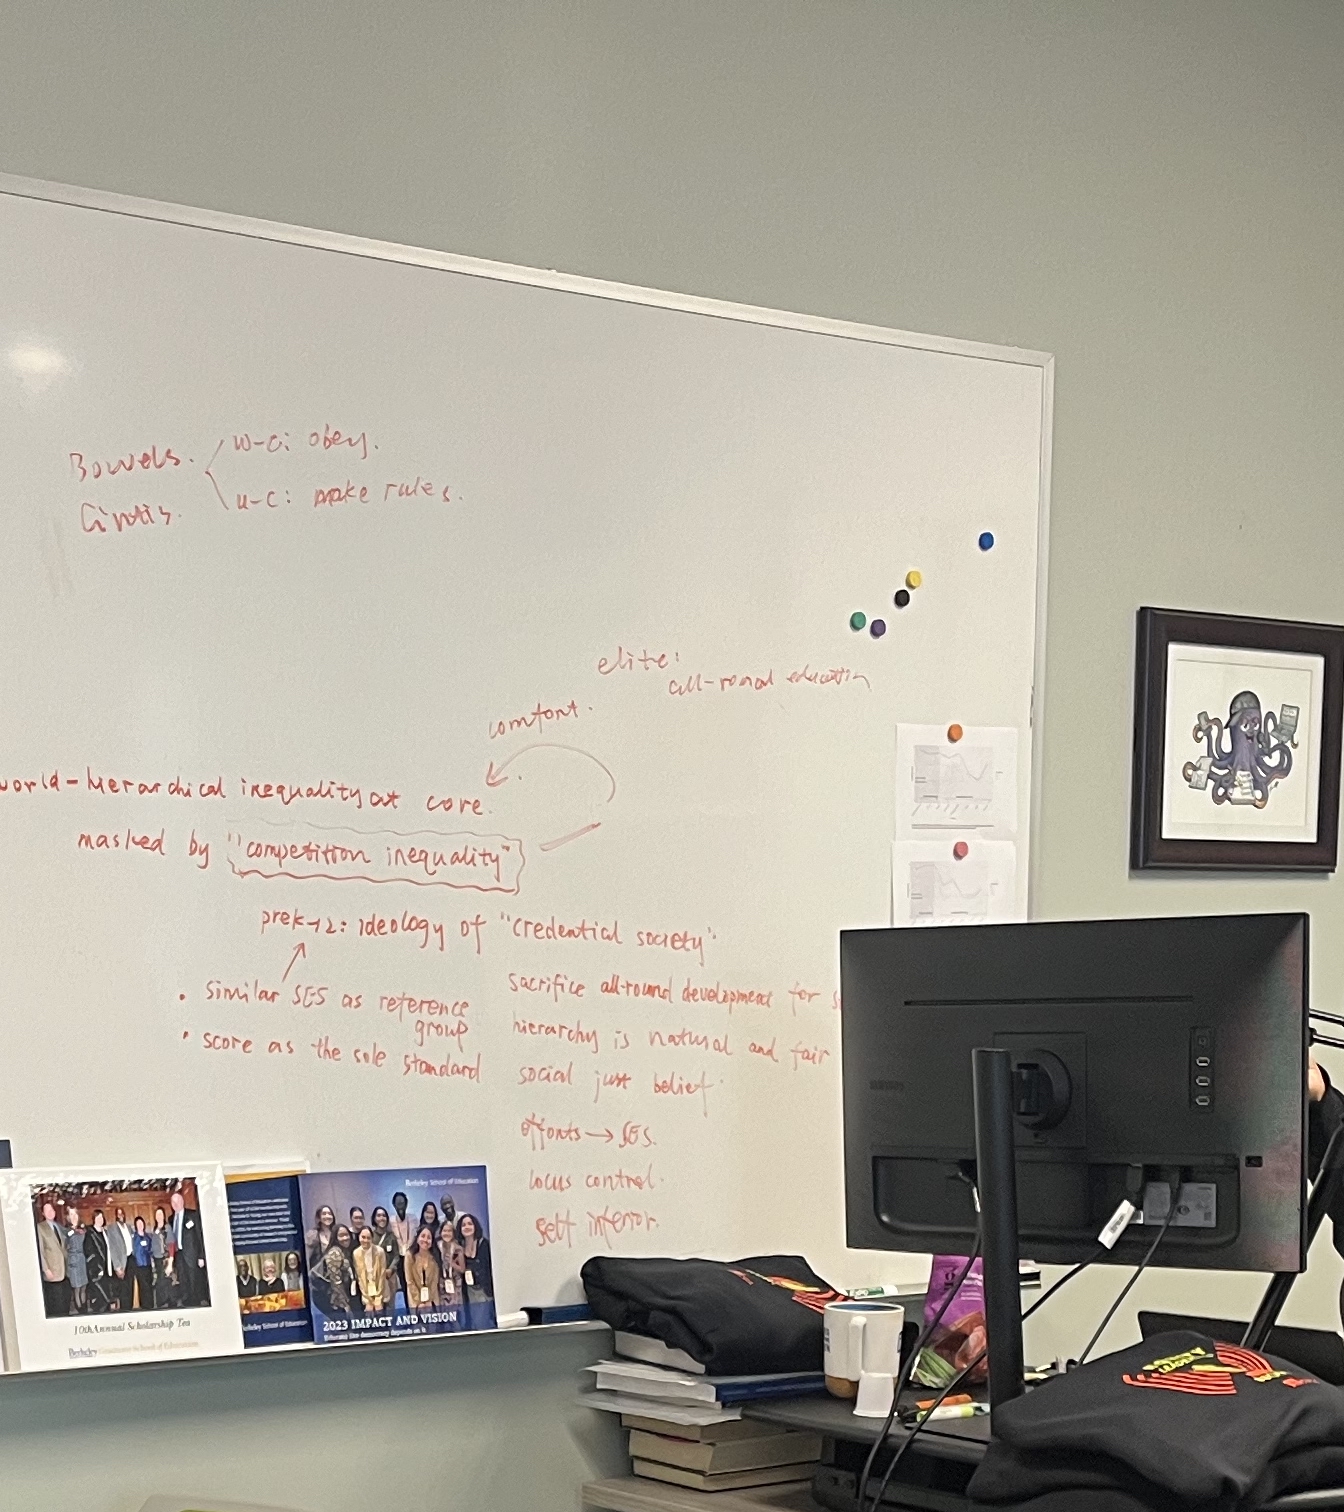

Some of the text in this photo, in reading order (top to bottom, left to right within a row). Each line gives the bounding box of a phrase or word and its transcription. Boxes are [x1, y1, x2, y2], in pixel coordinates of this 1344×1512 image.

[240, 776, 363, 809] inequality
[369, 789, 402, 810] at
[77, 828, 166, 857] masked
[188, 829, 211, 870] by
[460, 914, 488, 955] of
[291, 985, 329, 1009] SES
[341, 993, 363, 1009] as
[379, 990, 470, 1023] reference
[681, 977, 774, 1016] development
[787, 981, 822, 1017] for
[268, 1039, 294, 1054] as
[311, 1035, 342, 1062] the
[414, 1017, 469, 1053] group
[512, 1011, 831, 1072] hierarchy is natural and fair
[323, 1311, 457, 1332] 2023 IMPACT AND VISION
